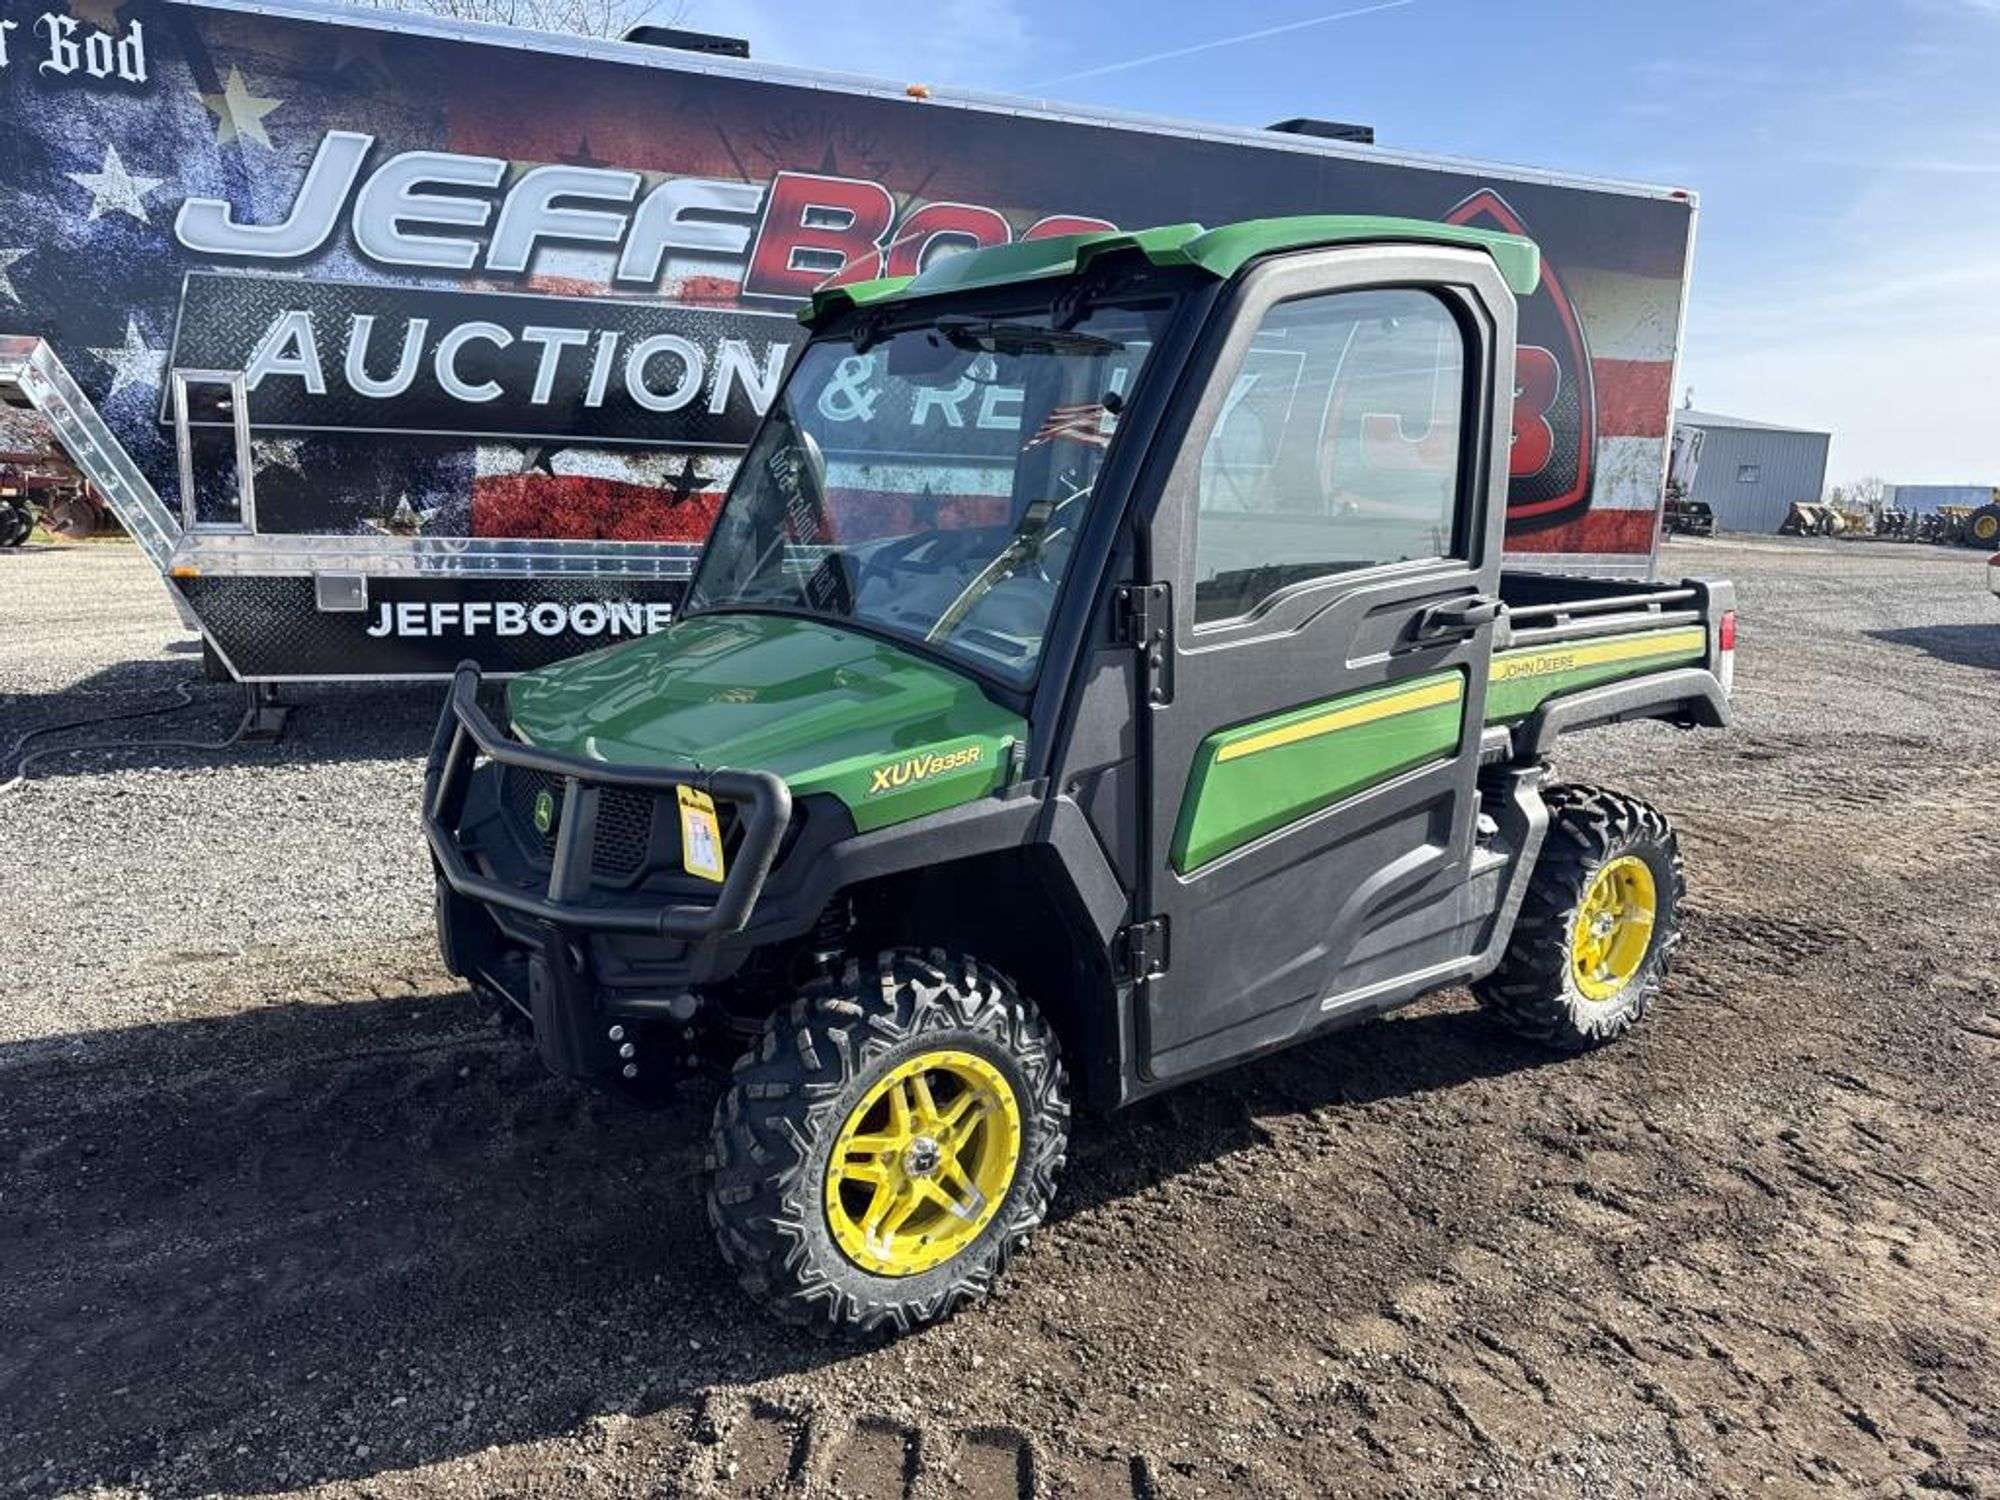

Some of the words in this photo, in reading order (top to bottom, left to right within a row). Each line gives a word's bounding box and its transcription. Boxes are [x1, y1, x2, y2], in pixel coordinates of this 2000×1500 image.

[246, 309, 791, 418] AUCTION
[817, 354, 883, 422] &
[366, 601, 673, 637] JEFFBOONE
[1501, 662, 1536, 679] JOHN
[1537, 655, 1574, 674] DEERE
[869, 745, 981, 793] XUV835R
